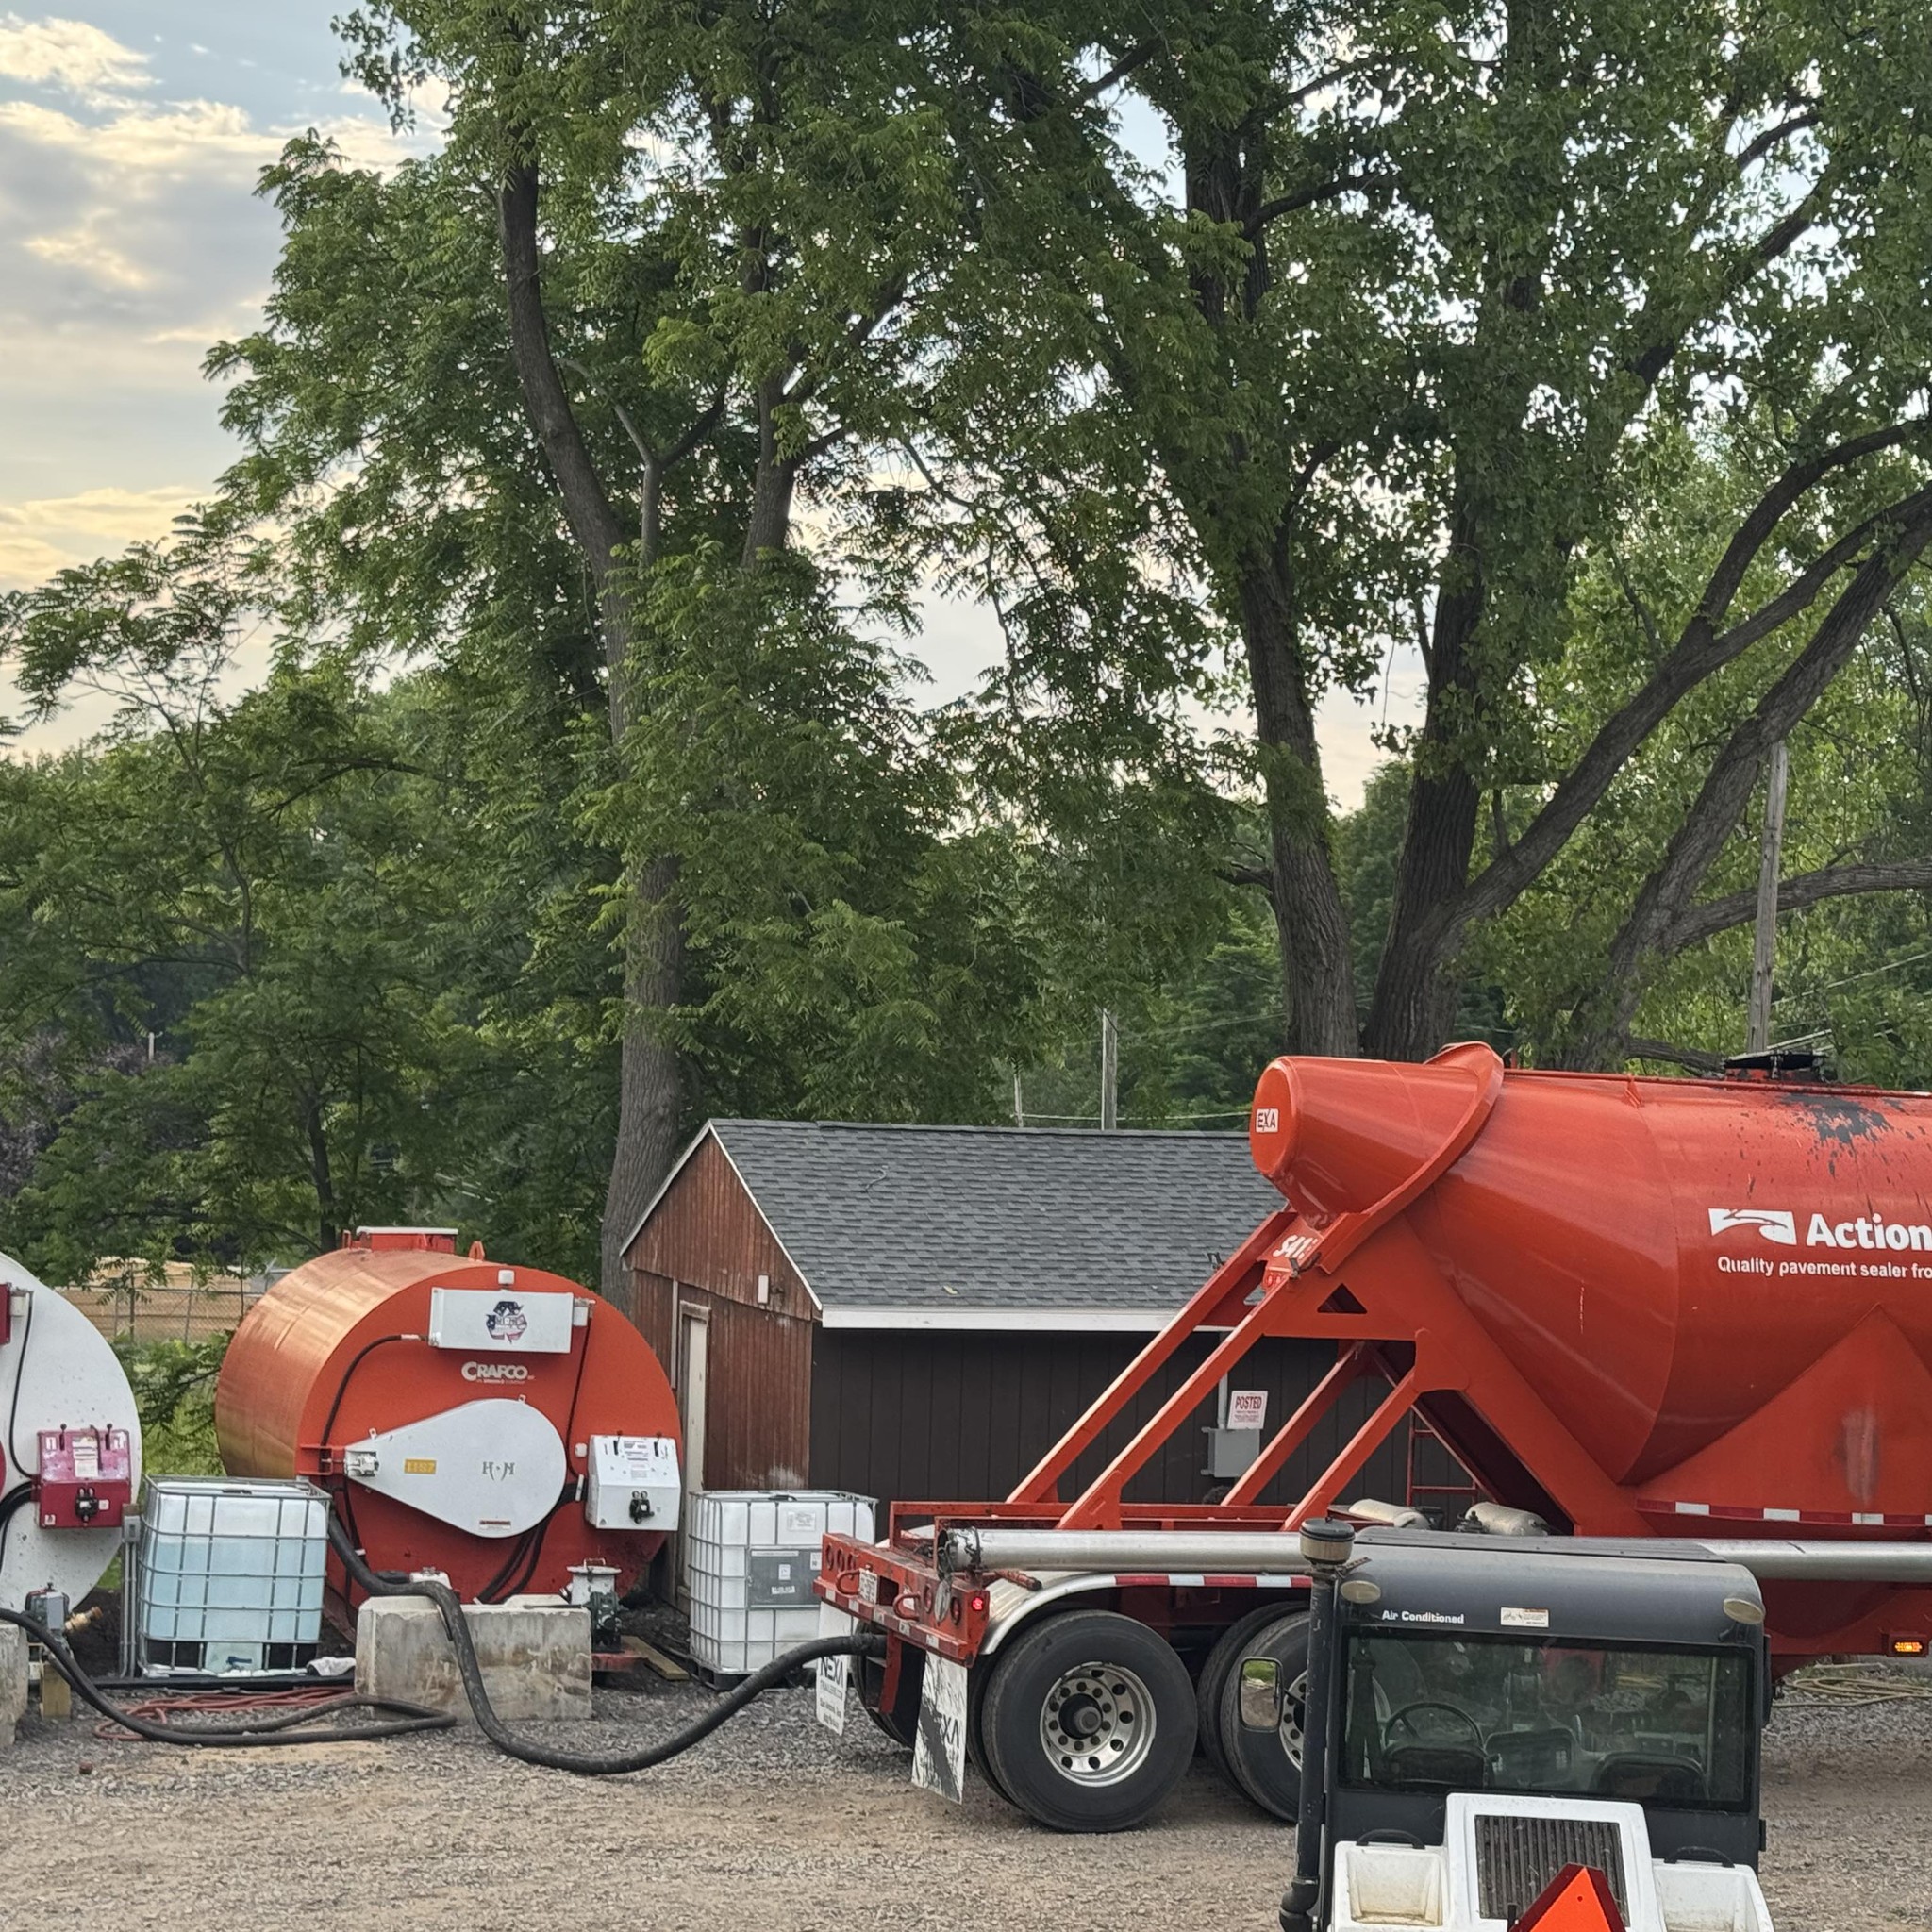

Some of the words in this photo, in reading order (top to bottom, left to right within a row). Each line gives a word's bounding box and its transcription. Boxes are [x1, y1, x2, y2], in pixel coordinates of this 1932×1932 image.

[1806, 1213, 1932, 1251] Action
[1718, 1256, 1774, 1277] Quality
[1779, 1261, 1857, 1277] pavement
[1860, 1261, 1907, 1278] sealer
[461, 1361, 528, 1381] CRAFCO
[1236, 1396, 1262, 1409] POSTED
[1382, 1609, 1398, 1621] Air
[1401, 1610, 1465, 1624] Conditioned
